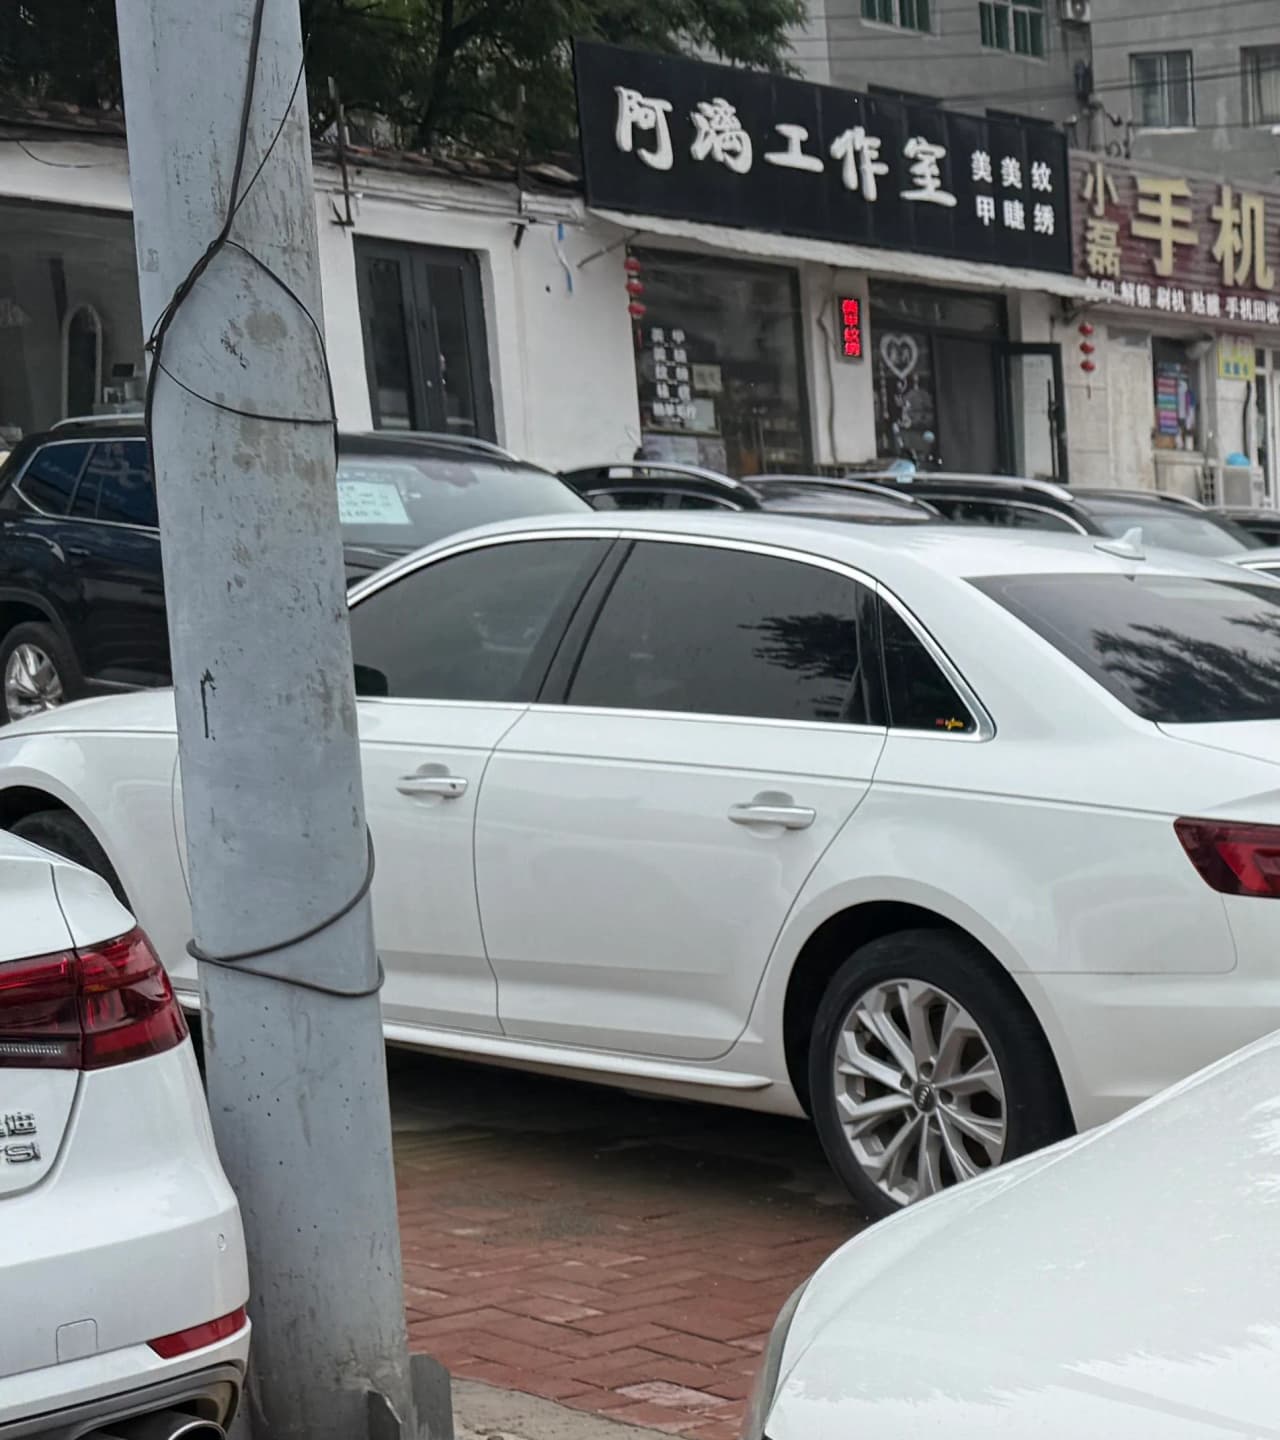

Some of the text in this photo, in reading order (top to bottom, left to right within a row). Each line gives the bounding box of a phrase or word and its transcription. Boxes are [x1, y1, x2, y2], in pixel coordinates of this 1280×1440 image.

[613, 85, 958, 207] 阿漓工作室
[970, 150, 997, 226] 美甲
[0, 1142, 41, 1164] SI
